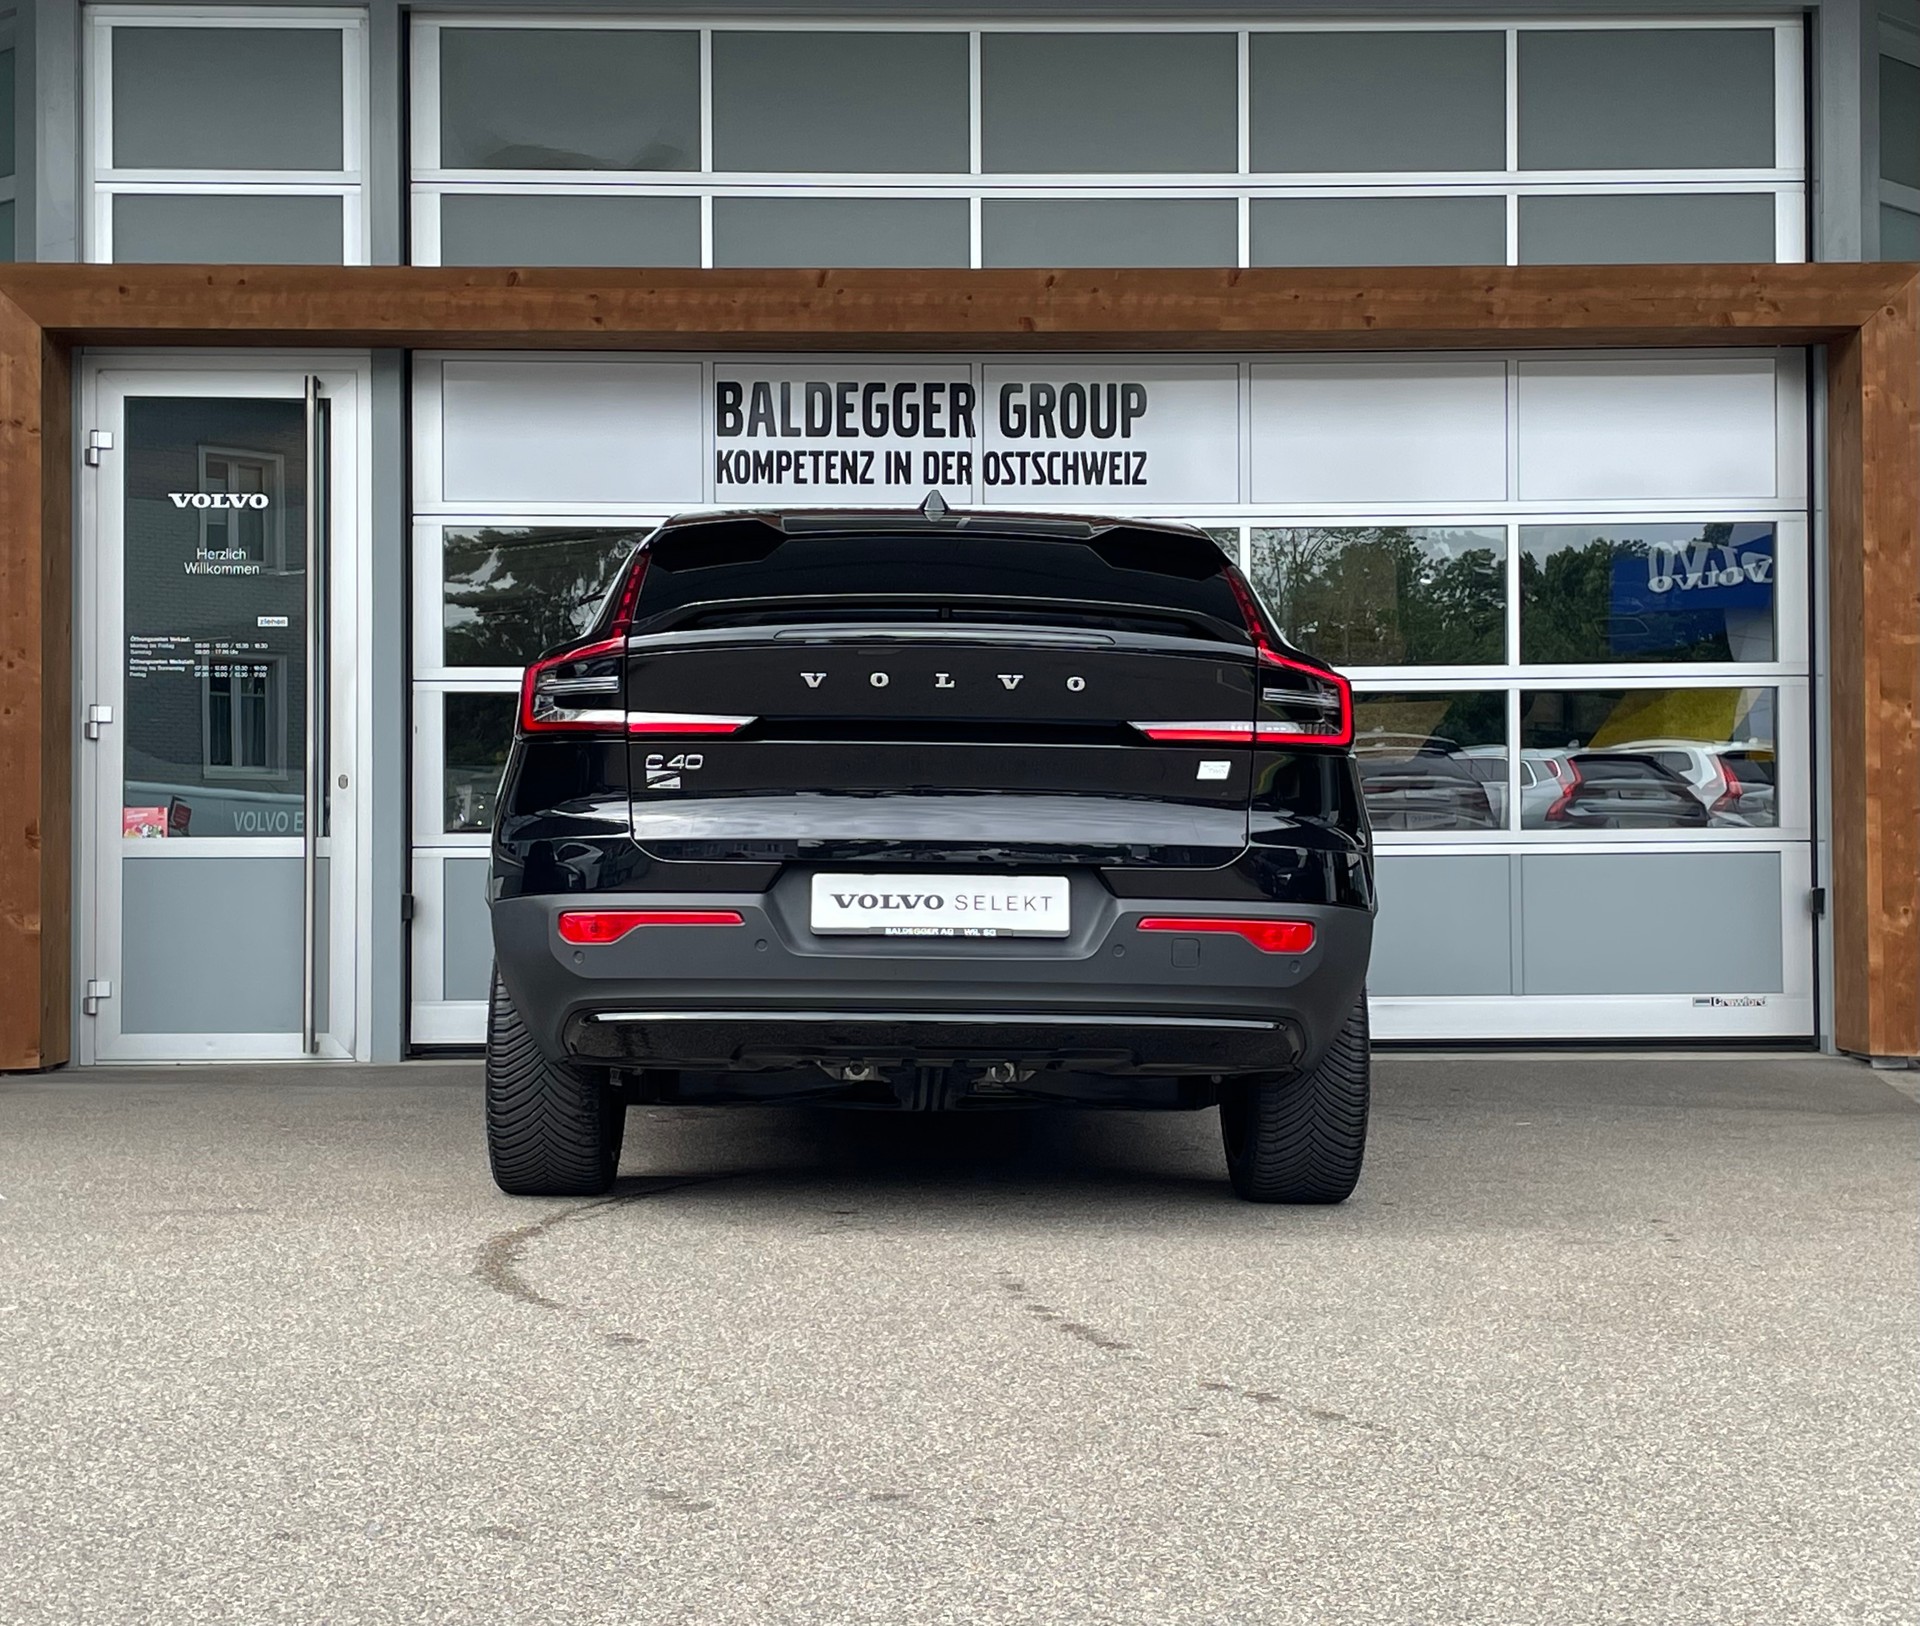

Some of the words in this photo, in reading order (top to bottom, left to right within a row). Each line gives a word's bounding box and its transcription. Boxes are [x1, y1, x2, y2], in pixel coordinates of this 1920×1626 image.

[716, 381, 976, 438] BALDEGGER
[1000, 383, 1147, 439] GROUP
[716, 450, 874, 485] KOMPETENZ
[885, 451, 912, 485] IN
[923, 451, 973, 485] DER
[983, 451, 1147, 486] OSTSCHWEIZ
[168, 493, 269, 509] VOLVO
[196, 548, 247, 560] Herzlich
[184, 562, 260, 575] Willkommen
[800, 672, 1086, 692] VOLVO
[233, 811, 289, 833] VOLVO
[830, 893, 945, 910] VOLVO
[954, 895, 1053, 911] SELEKT
